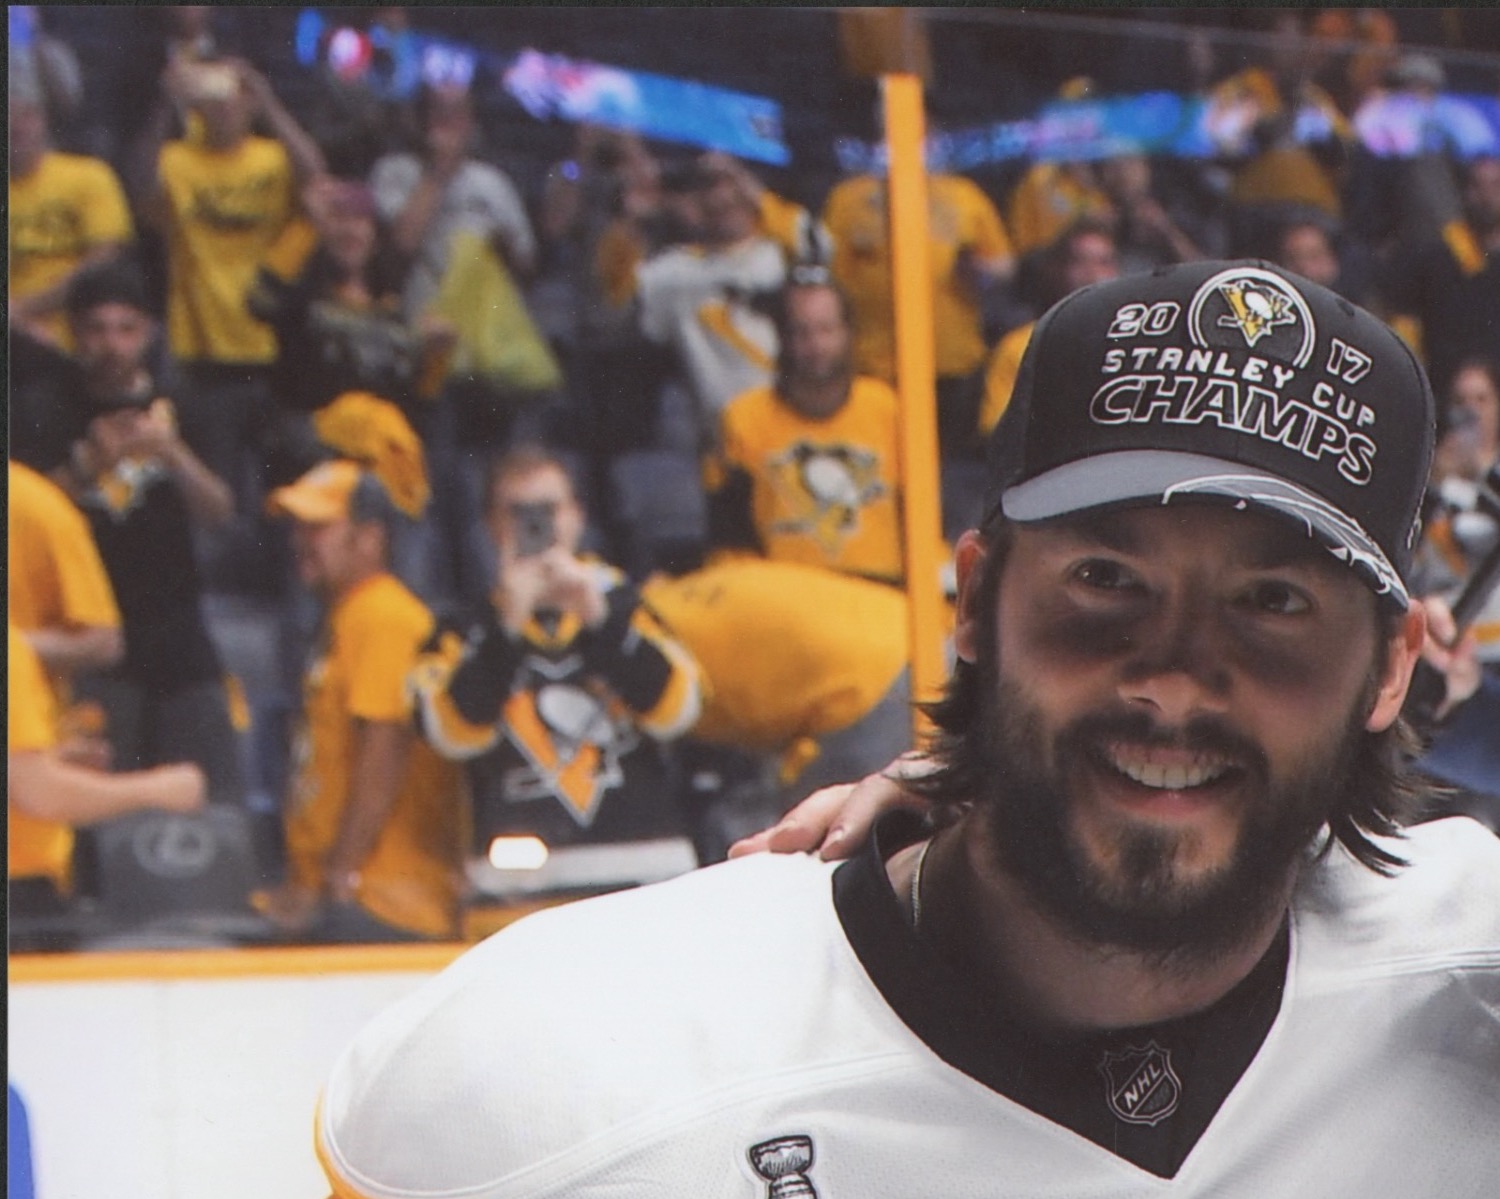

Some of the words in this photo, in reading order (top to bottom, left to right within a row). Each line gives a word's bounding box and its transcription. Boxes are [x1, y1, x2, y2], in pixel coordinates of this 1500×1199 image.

[1107, 302, 1181, 337] 20
[1326, 338, 1372, 384] 17
[1102, 347, 1294, 389] STANLEY
[1312, 382, 1375, 426] CUP
[1089, 375, 1377, 485] CHAMPS
[1124, 1063, 1161, 1110] NHL
